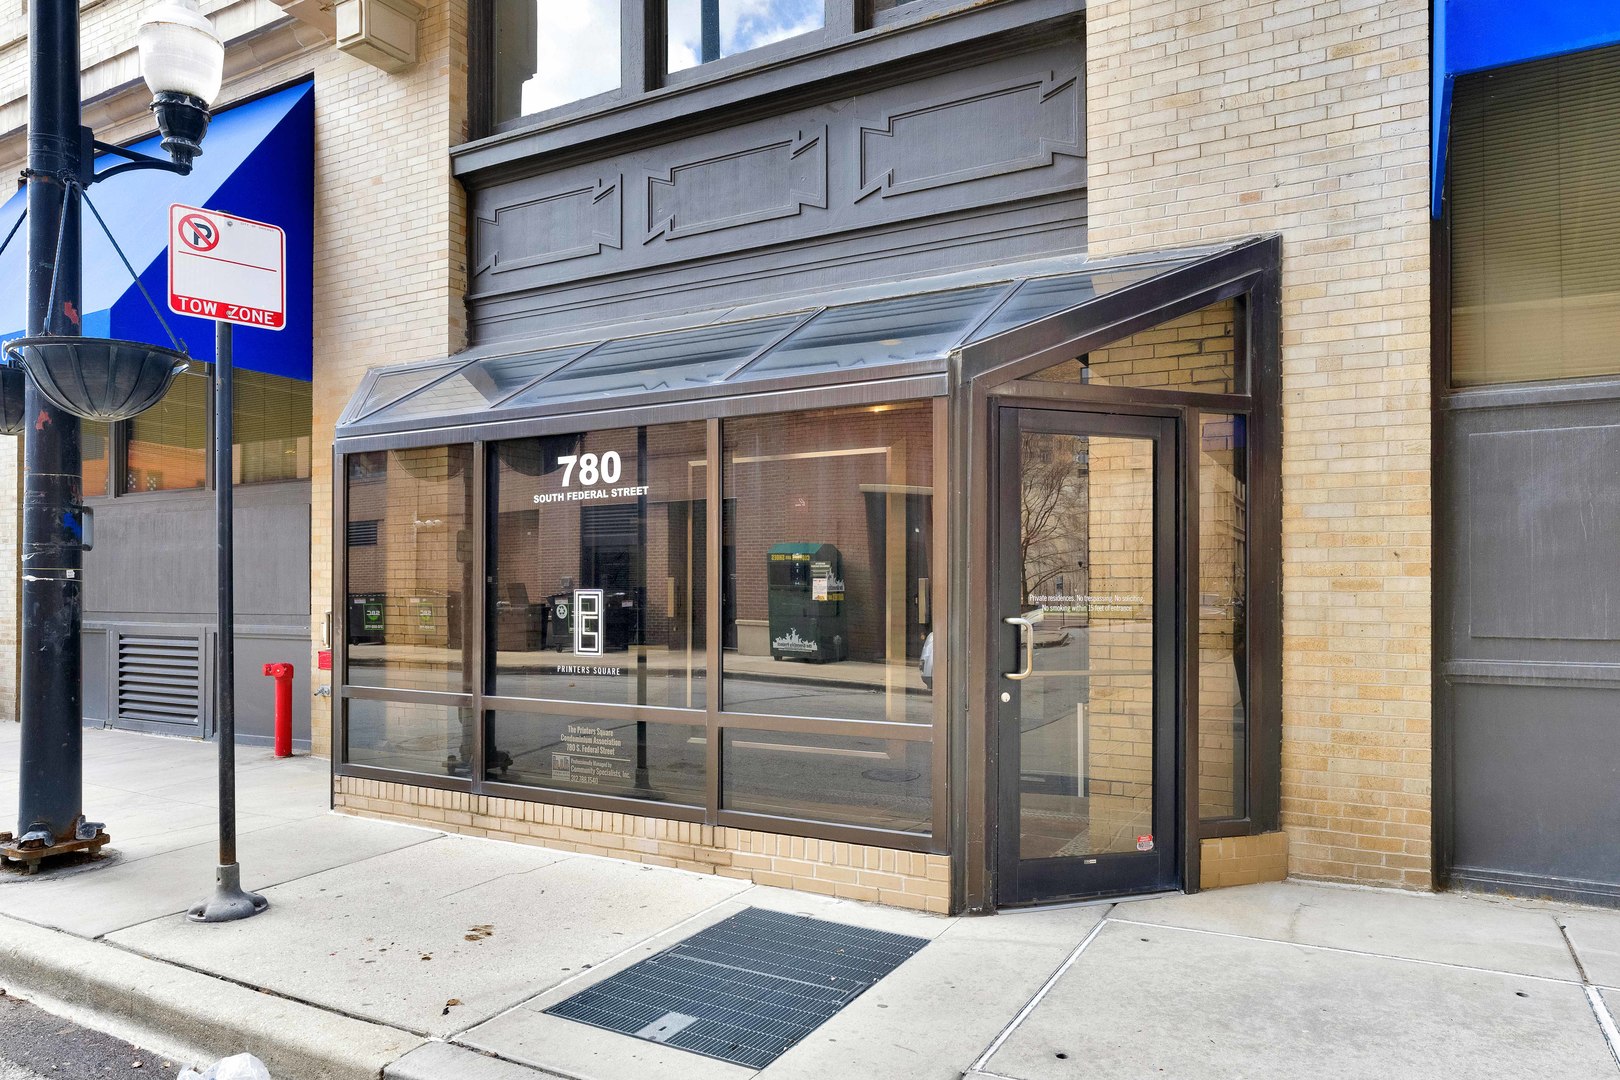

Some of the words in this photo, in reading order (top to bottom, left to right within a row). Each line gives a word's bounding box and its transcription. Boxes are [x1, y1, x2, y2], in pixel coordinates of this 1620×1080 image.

[178, 296, 217, 316] TOW
[228, 305, 275, 326] ZONE
[557, 450, 622, 487] 780
[533, 492, 565, 504] SOUTH
[567, 489, 609, 501] FEDERAL
[611, 486, 649, 498] STREET
[1029, 594, 1048, 603] Private
[1076, 594, 1084, 602] No
[1050, 605, 1071, 613] smoking
[557, 665, 590, 674] PRINTERS
[593, 666, 621, 676] SQUARE
[568, 725, 576, 734] The
[577, 726, 596, 735] Printers
[596, 727, 613, 737] Square
[560, 733, 593, 744] Condominium
[593, 735, 622, 747] Association
[566, 743, 576, 752] 780
[576, 744, 582, 752] S.
[582, 744, 600, 754] Federal
[600, 746, 615, 756] Street
[570, 765, 595, 775] Community
